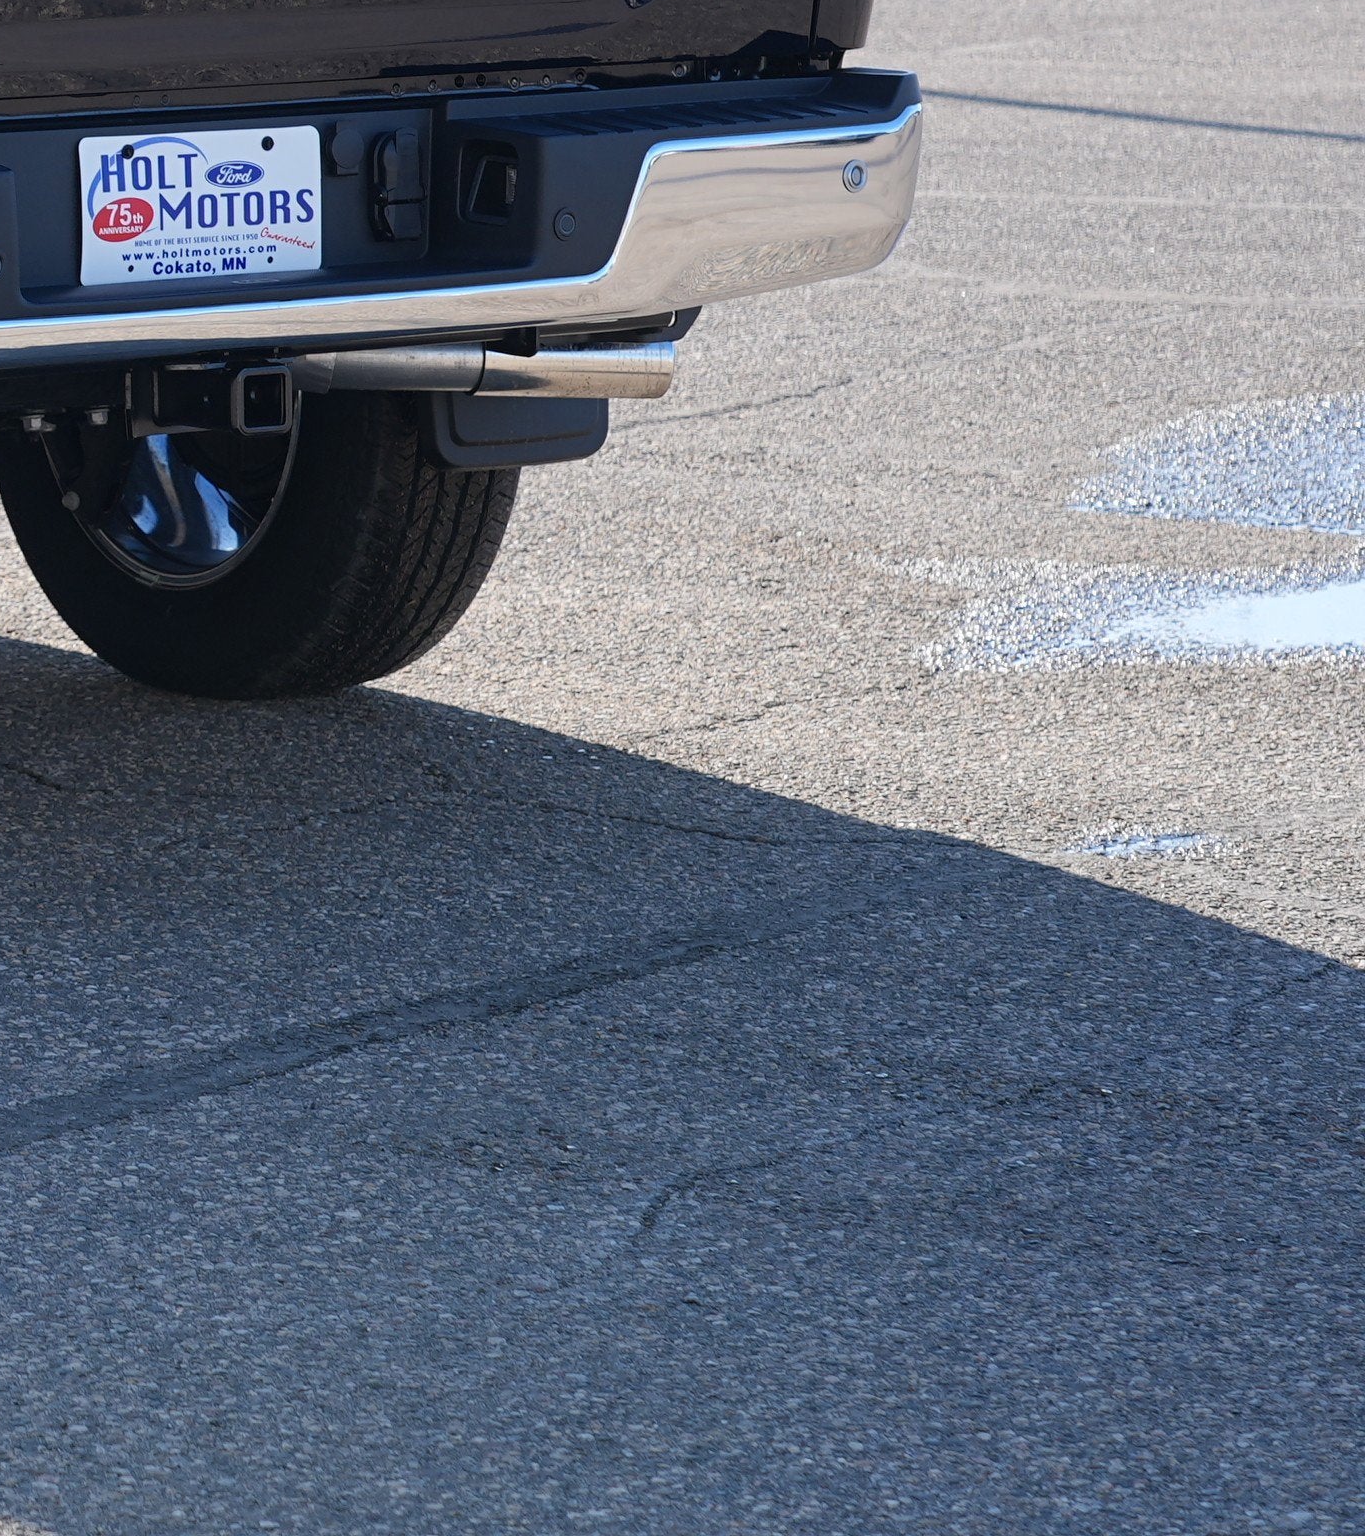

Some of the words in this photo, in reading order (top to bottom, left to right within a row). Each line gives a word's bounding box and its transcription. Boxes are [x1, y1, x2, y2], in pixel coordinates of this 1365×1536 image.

[101, 153, 199, 193] HOLT
[216, 164, 253, 184] Ford
[106, 203, 144, 227] 75th
[159, 188, 314, 231] MOTORS
[98, 225, 144, 235] ANNIVERSARY
[260, 226, 315, 250] Guaranteed
[134, 239, 153, 247] HOME
[176, 237, 192, 245] BEST
[193, 235, 219, 243] SERVICE
[221, 234, 239, 242] SINCE
[122, 244, 277, 262] www.holtmotors.com
[152, 259, 216, 275] Cokato,
[222, 256, 247, 271] MN
